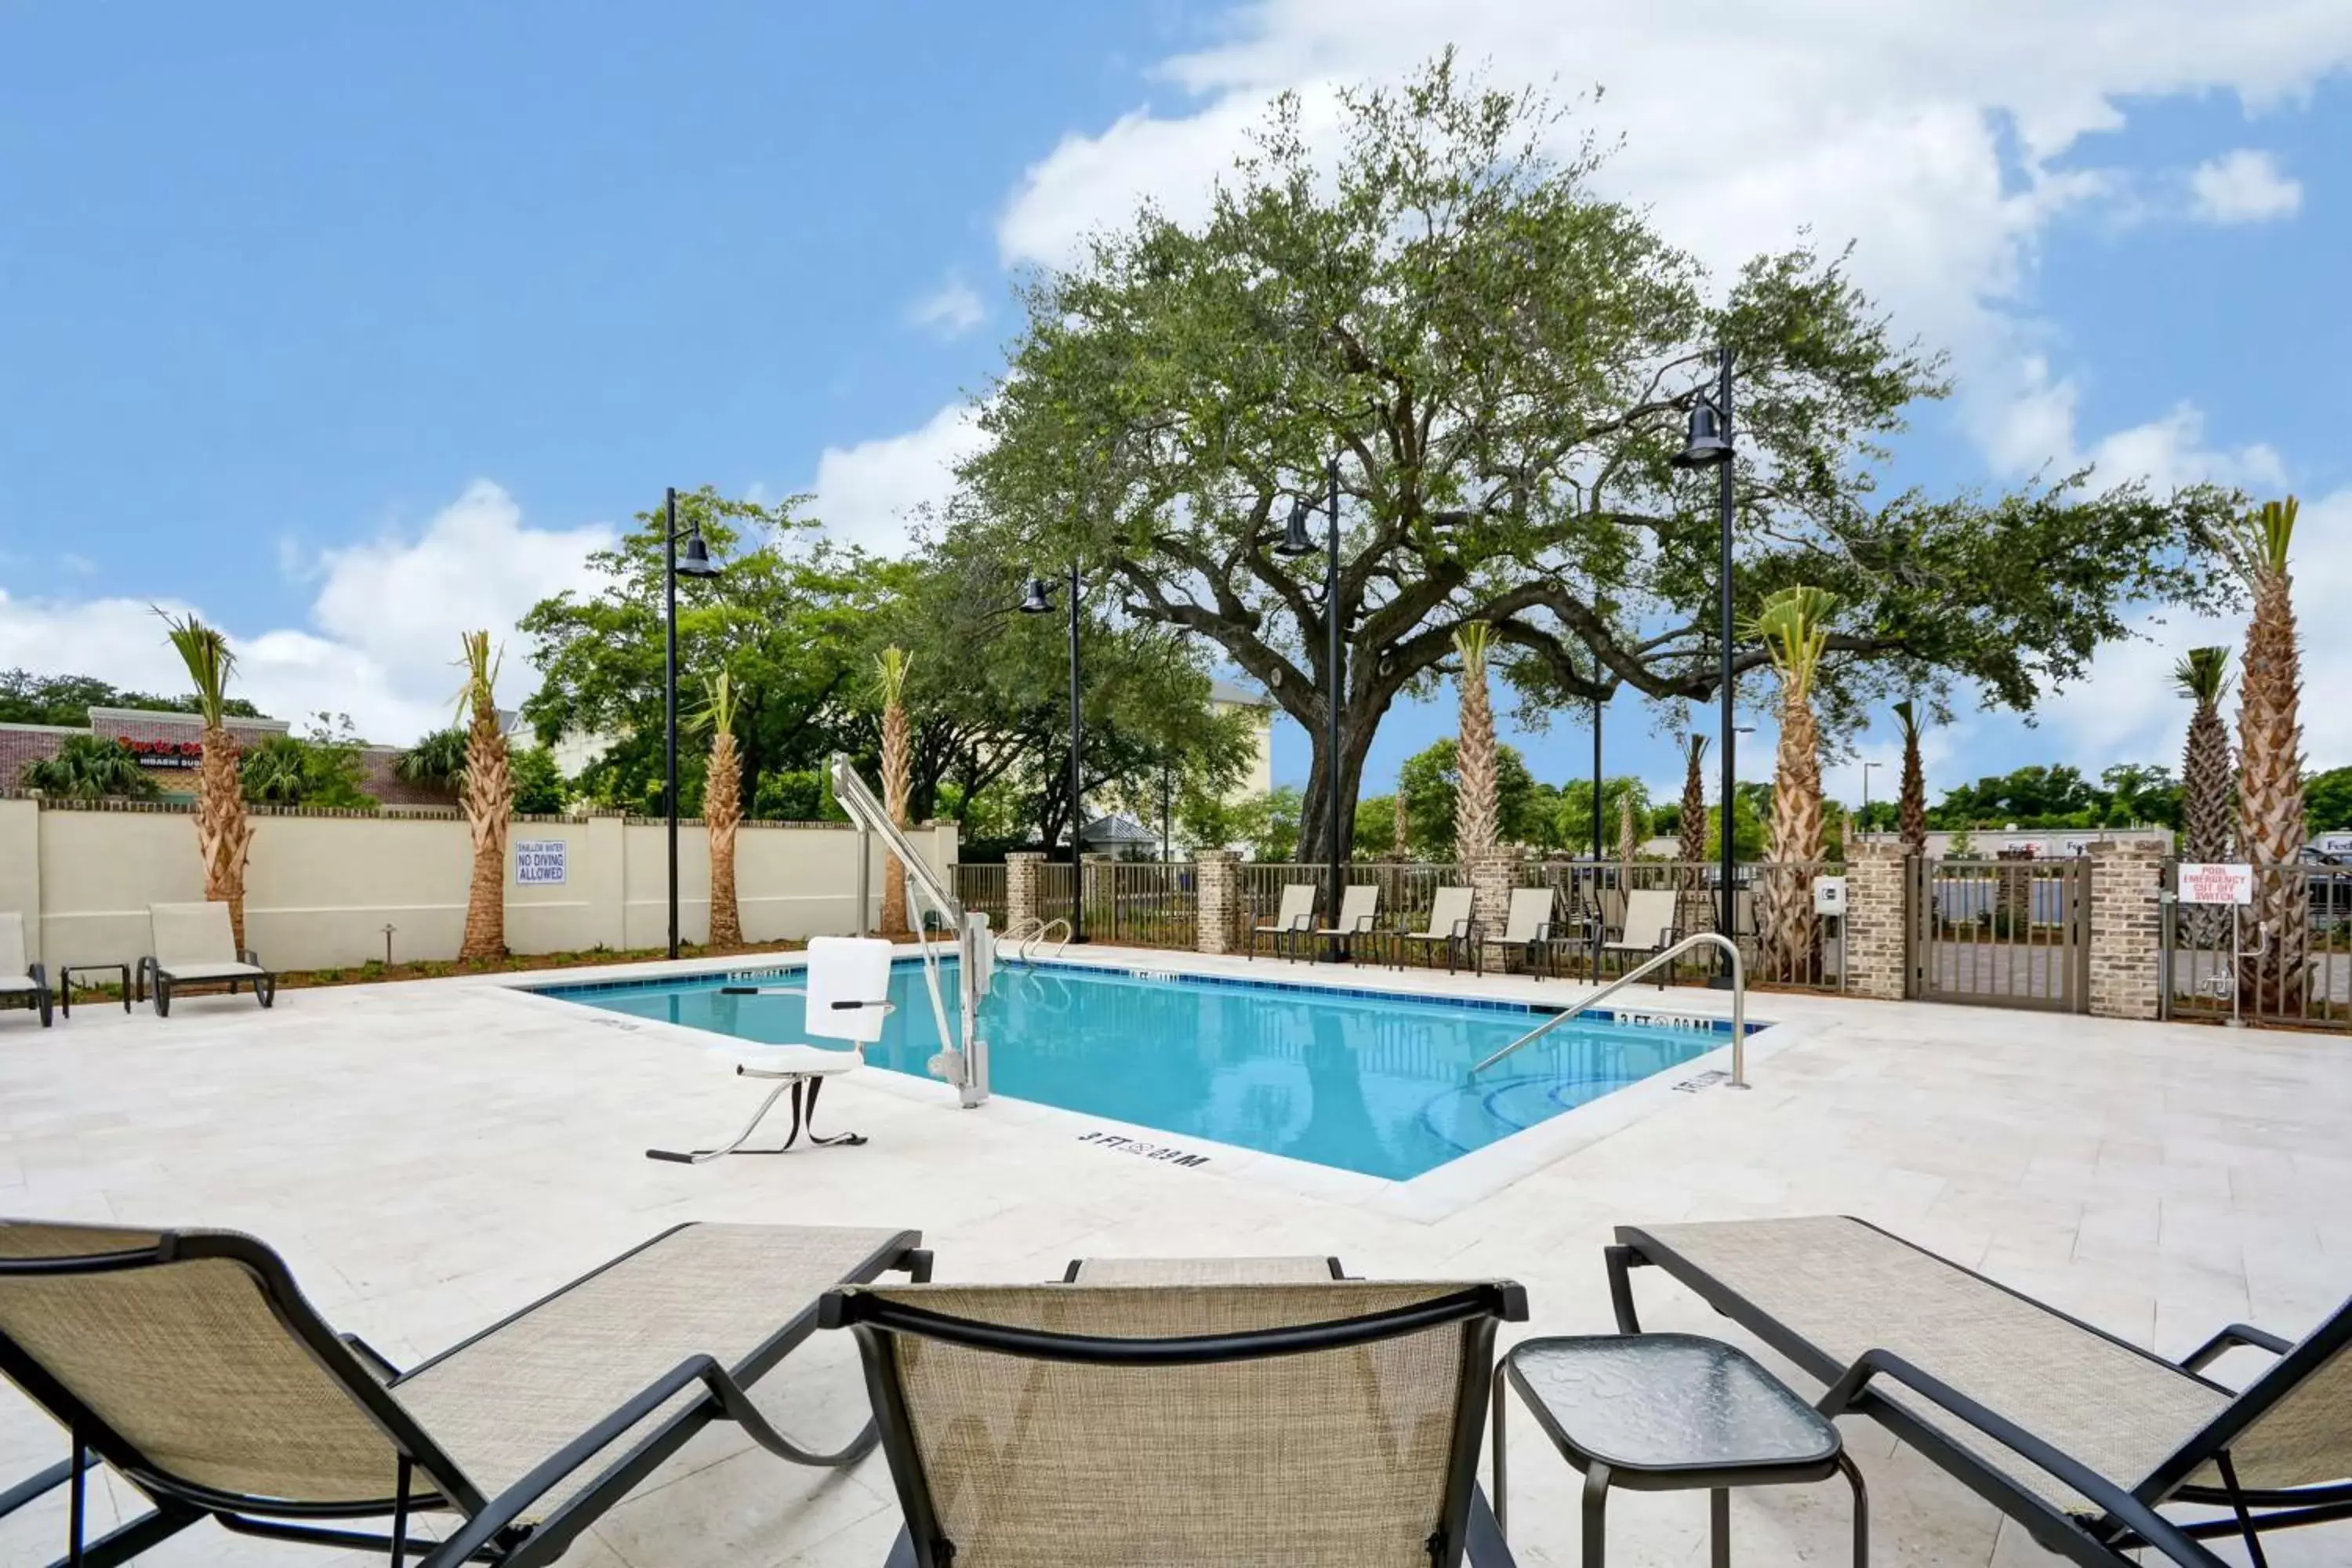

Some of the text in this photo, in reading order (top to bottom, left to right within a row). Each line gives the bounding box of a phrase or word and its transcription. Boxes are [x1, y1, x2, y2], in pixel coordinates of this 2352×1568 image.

[518, 854, 563, 866] NO DIVING
[519, 867, 563, 880] ALLOWED
[2183, 874, 2245, 884] EMERGENCY
[2216, 884, 2234, 892] OFF
[1094, 1136, 1134, 1148] FT
[1172, 1154, 1211, 1167] M
